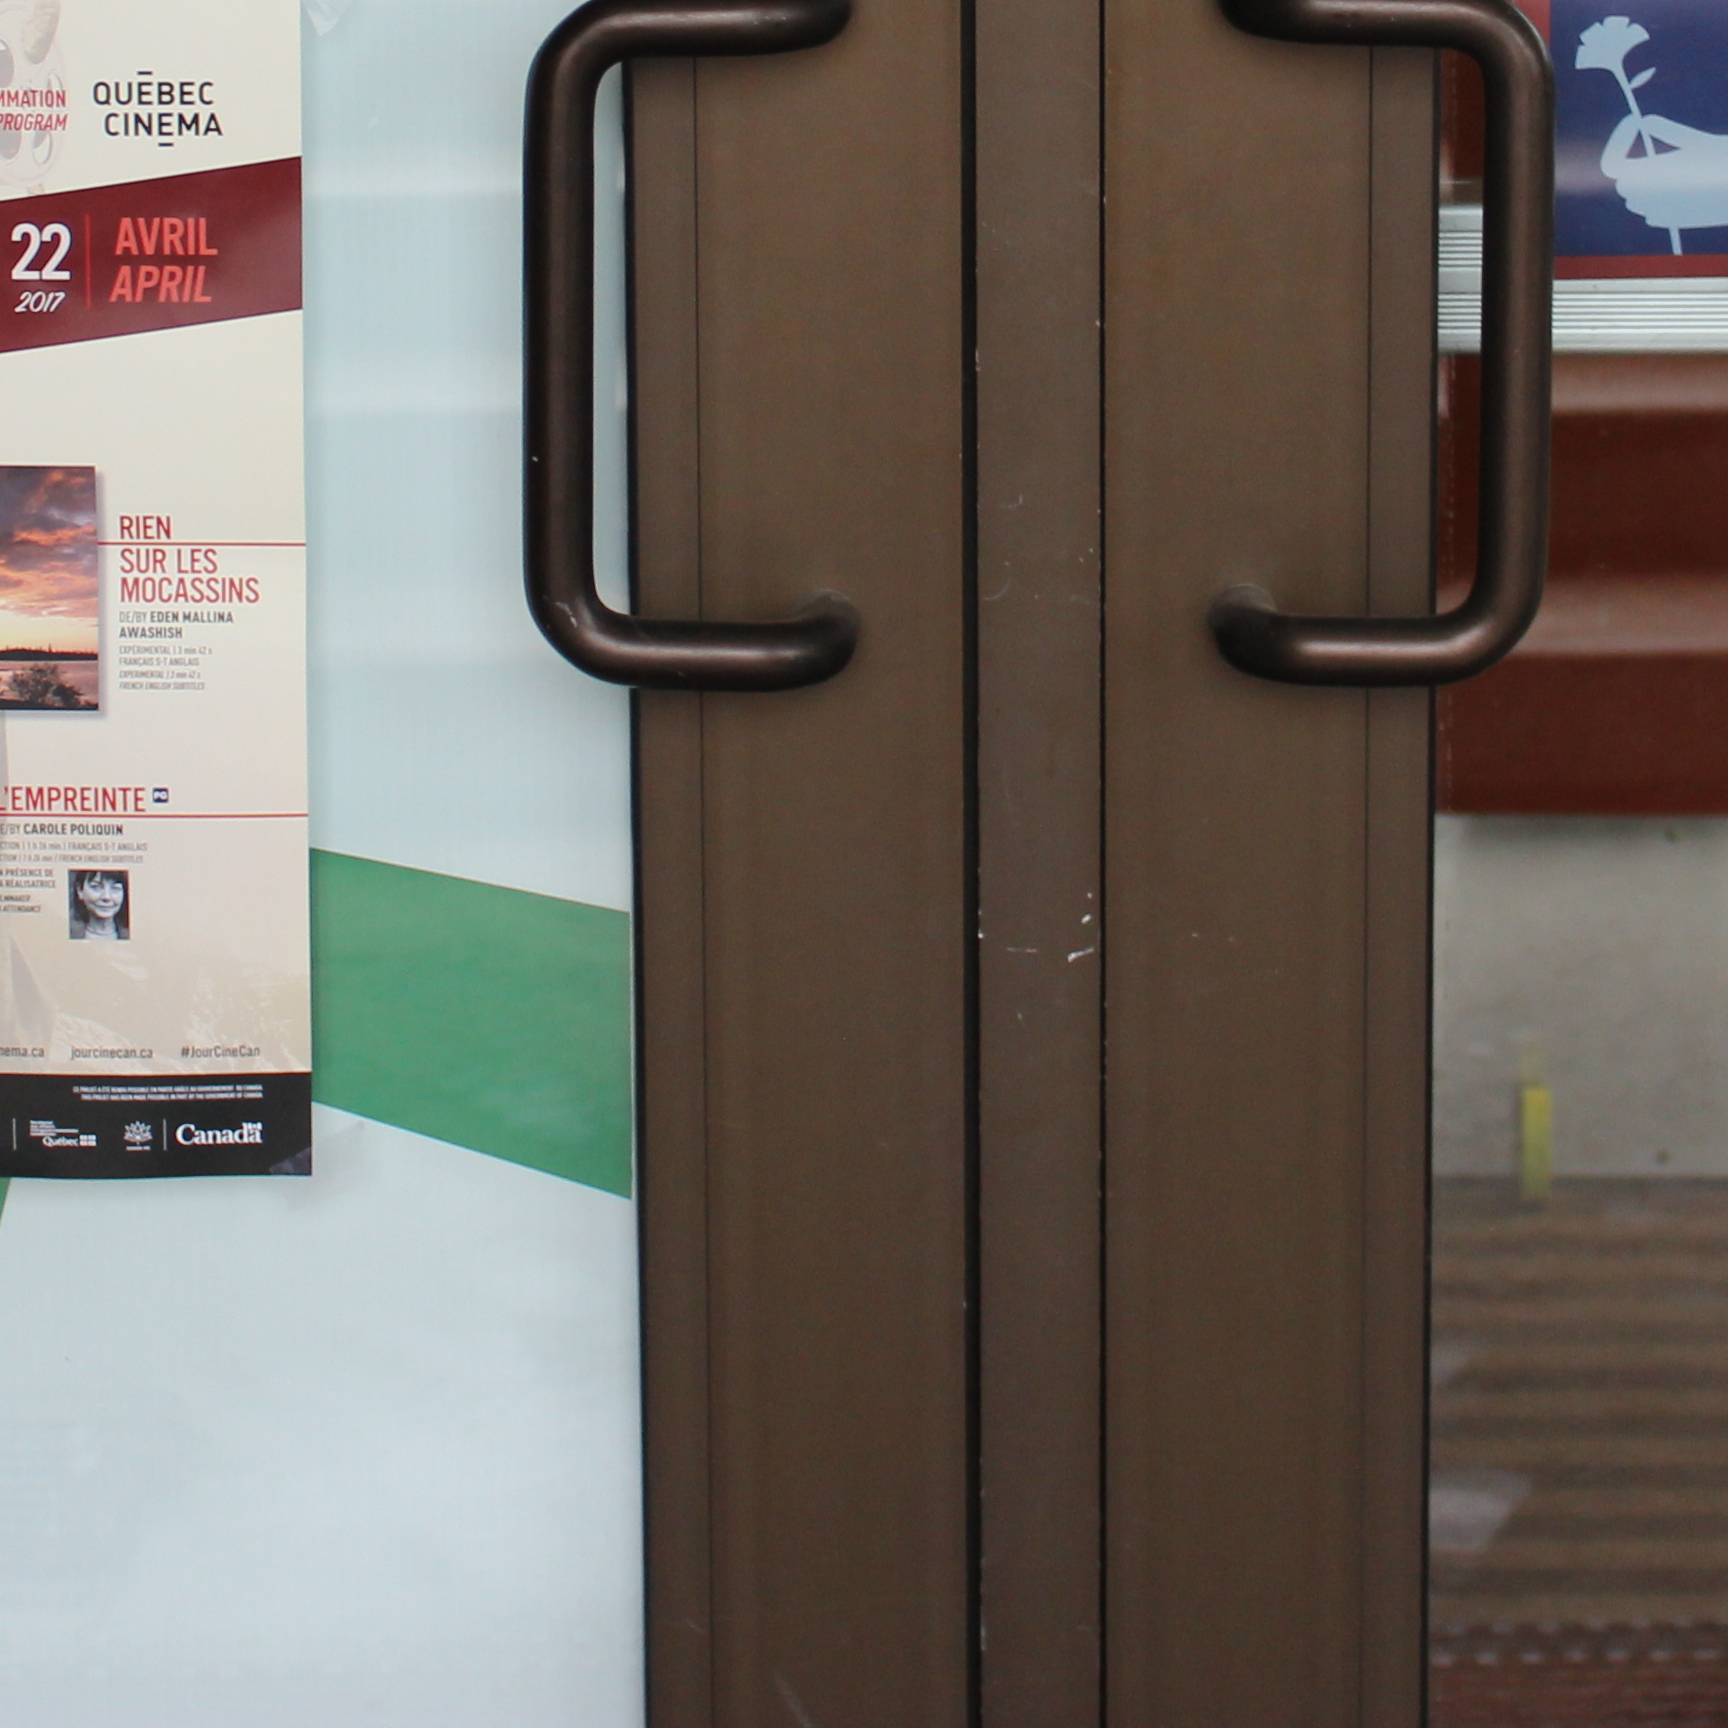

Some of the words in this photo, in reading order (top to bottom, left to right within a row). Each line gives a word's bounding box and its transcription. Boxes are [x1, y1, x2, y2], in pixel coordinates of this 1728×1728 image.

[115, 217, 218, 256] AVRIL
[11, 223, 71, 281] 22
[109, 265, 212, 303] APRIL
[14, 291, 66, 313] 2017
[120, 516, 171, 539] RIEN
[120, 548, 167, 573] SUR
[177, 549, 218, 573] LES
[120, 577, 259, 603] MOCASSINS
[150, 611, 179, 622] EDEN
[182, 612, 234, 623] MALLINA
[119, 627, 182, 638] AWASHISH
[24, 824, 67, 835] CAROLE
[71, 825, 123, 835] POLIQUIN
[71, 1046, 153, 1060] jourcinecan.ca
[181, 1046, 260, 1058] #JourCineCan
[176, 1122, 263, 1145] Canada
